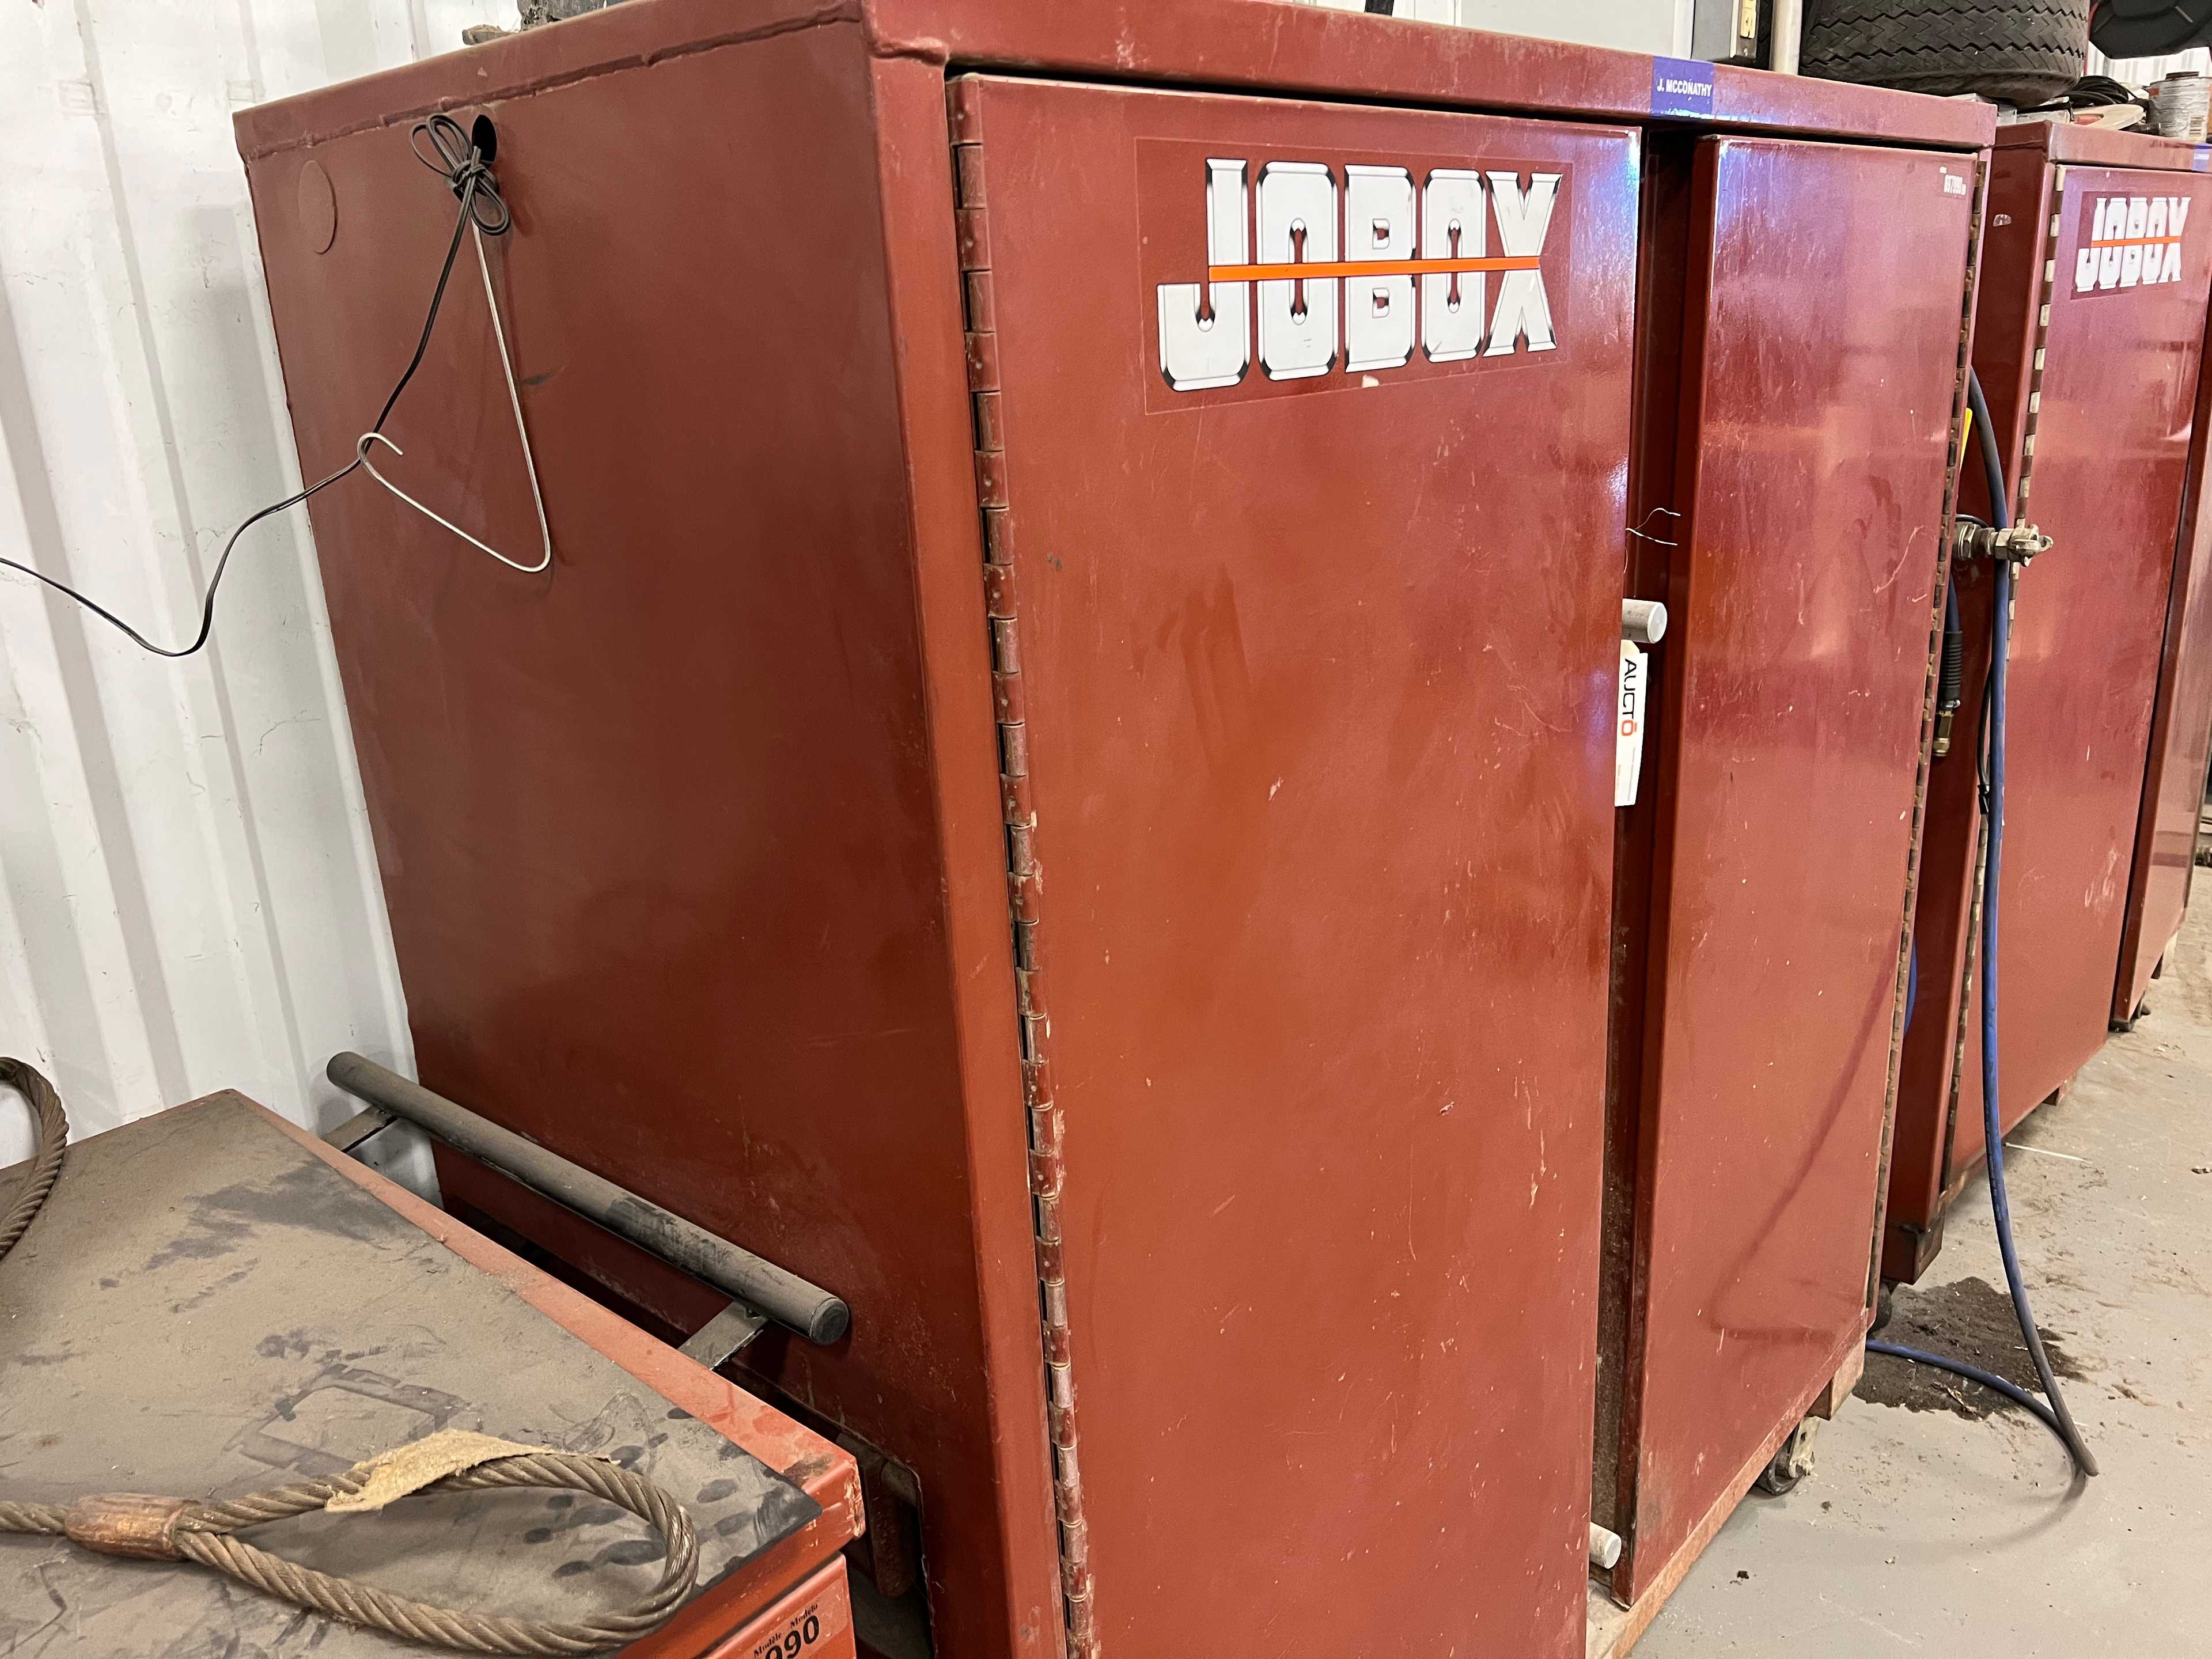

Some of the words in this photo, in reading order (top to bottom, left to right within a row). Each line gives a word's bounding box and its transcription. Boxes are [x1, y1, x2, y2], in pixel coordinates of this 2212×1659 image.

[1657, 78, 1665, 92] J.
[1666, 79, 1713, 97] MCCONATHY
[1157, 158, 1563, 391] JOBOX
[2075, 197, 2192, 293] JOBOX
